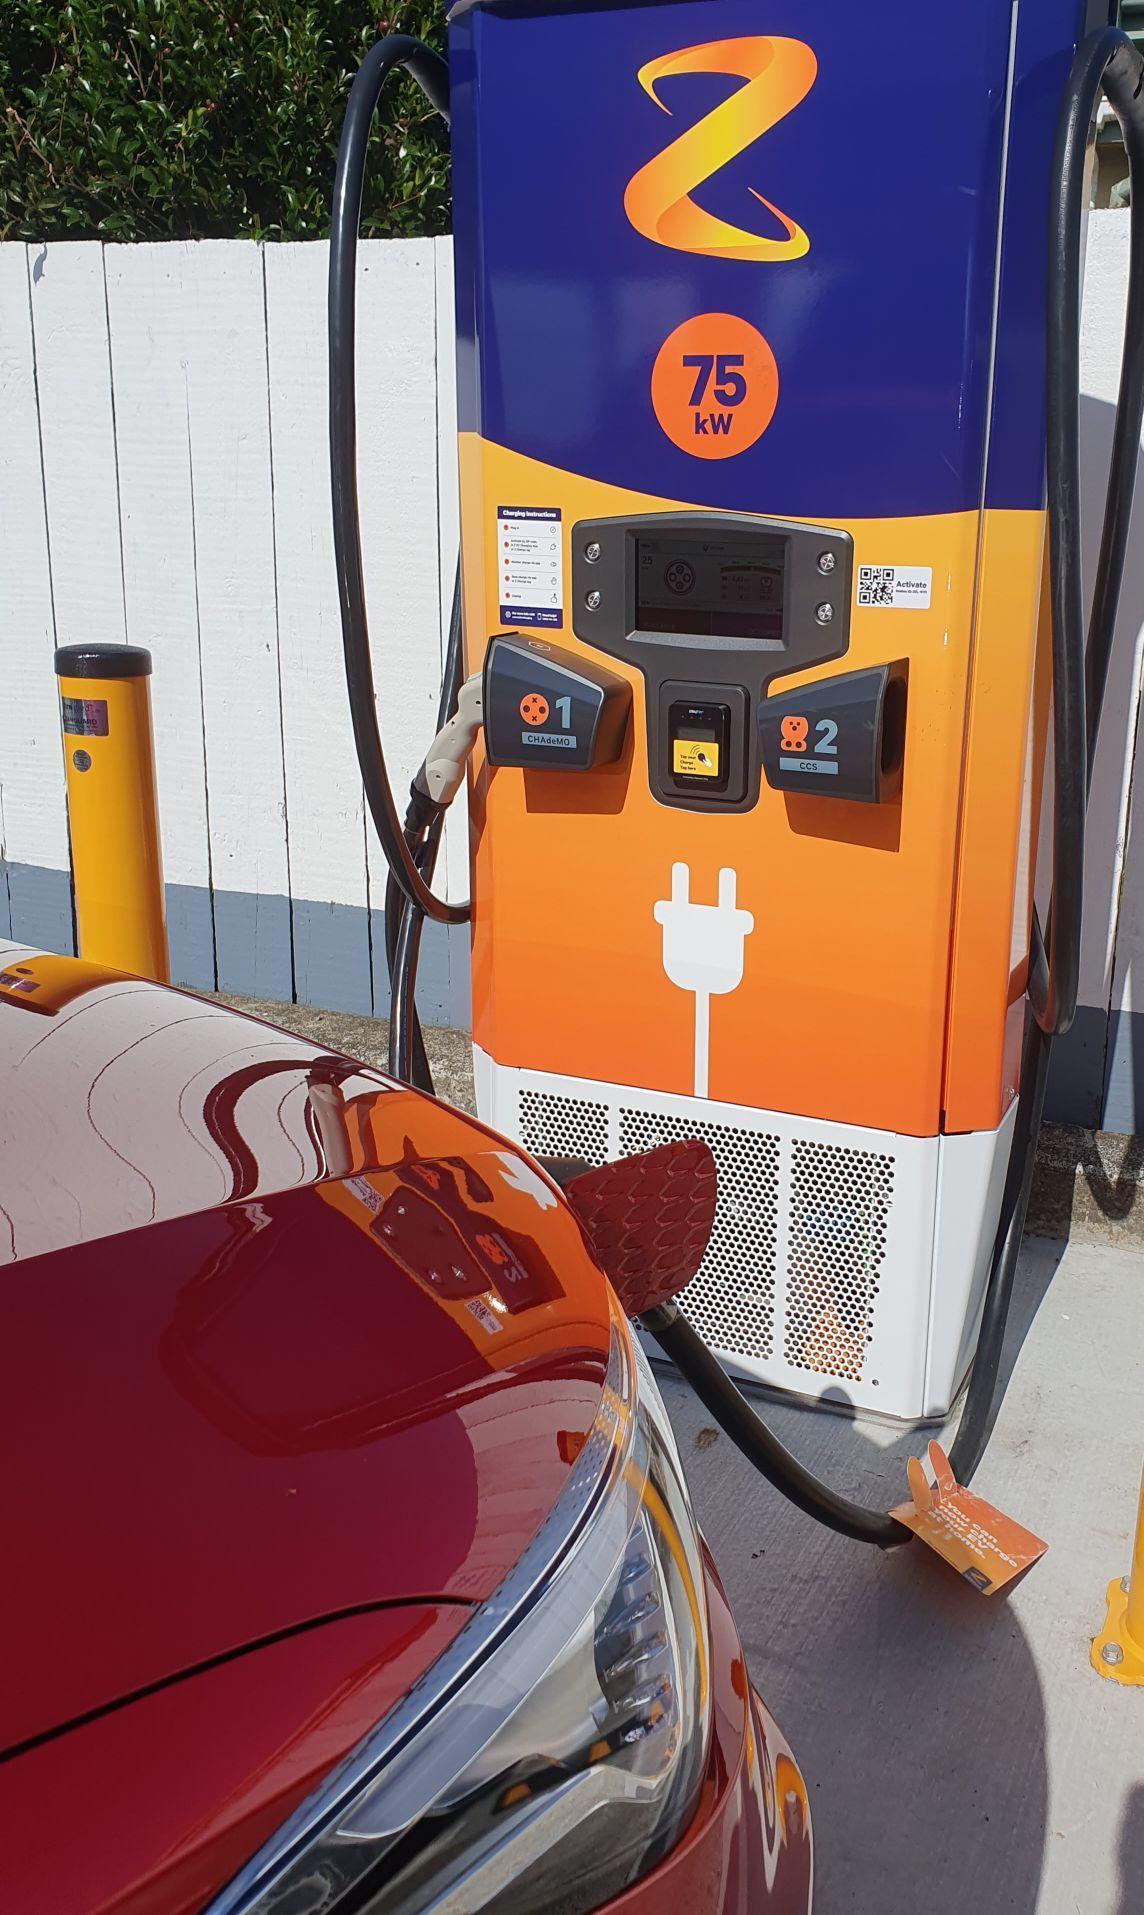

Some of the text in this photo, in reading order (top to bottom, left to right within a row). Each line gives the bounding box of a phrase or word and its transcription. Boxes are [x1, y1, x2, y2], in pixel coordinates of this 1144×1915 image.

[624, 36, 817, 261] Z
[683, 354, 747, 407] 75
[694, 412, 733, 435] kW
[502, 509, 557, 518] Charging Instructions
[556, 696, 571, 729] 1
[527, 735, 570, 746] CHAdeMO
[814, 718, 838, 755] 2
[799, 762, 818, 771] CCS
[939, 1504, 1018, 1568] now charge
[972, 1523, 998, 1543] can
